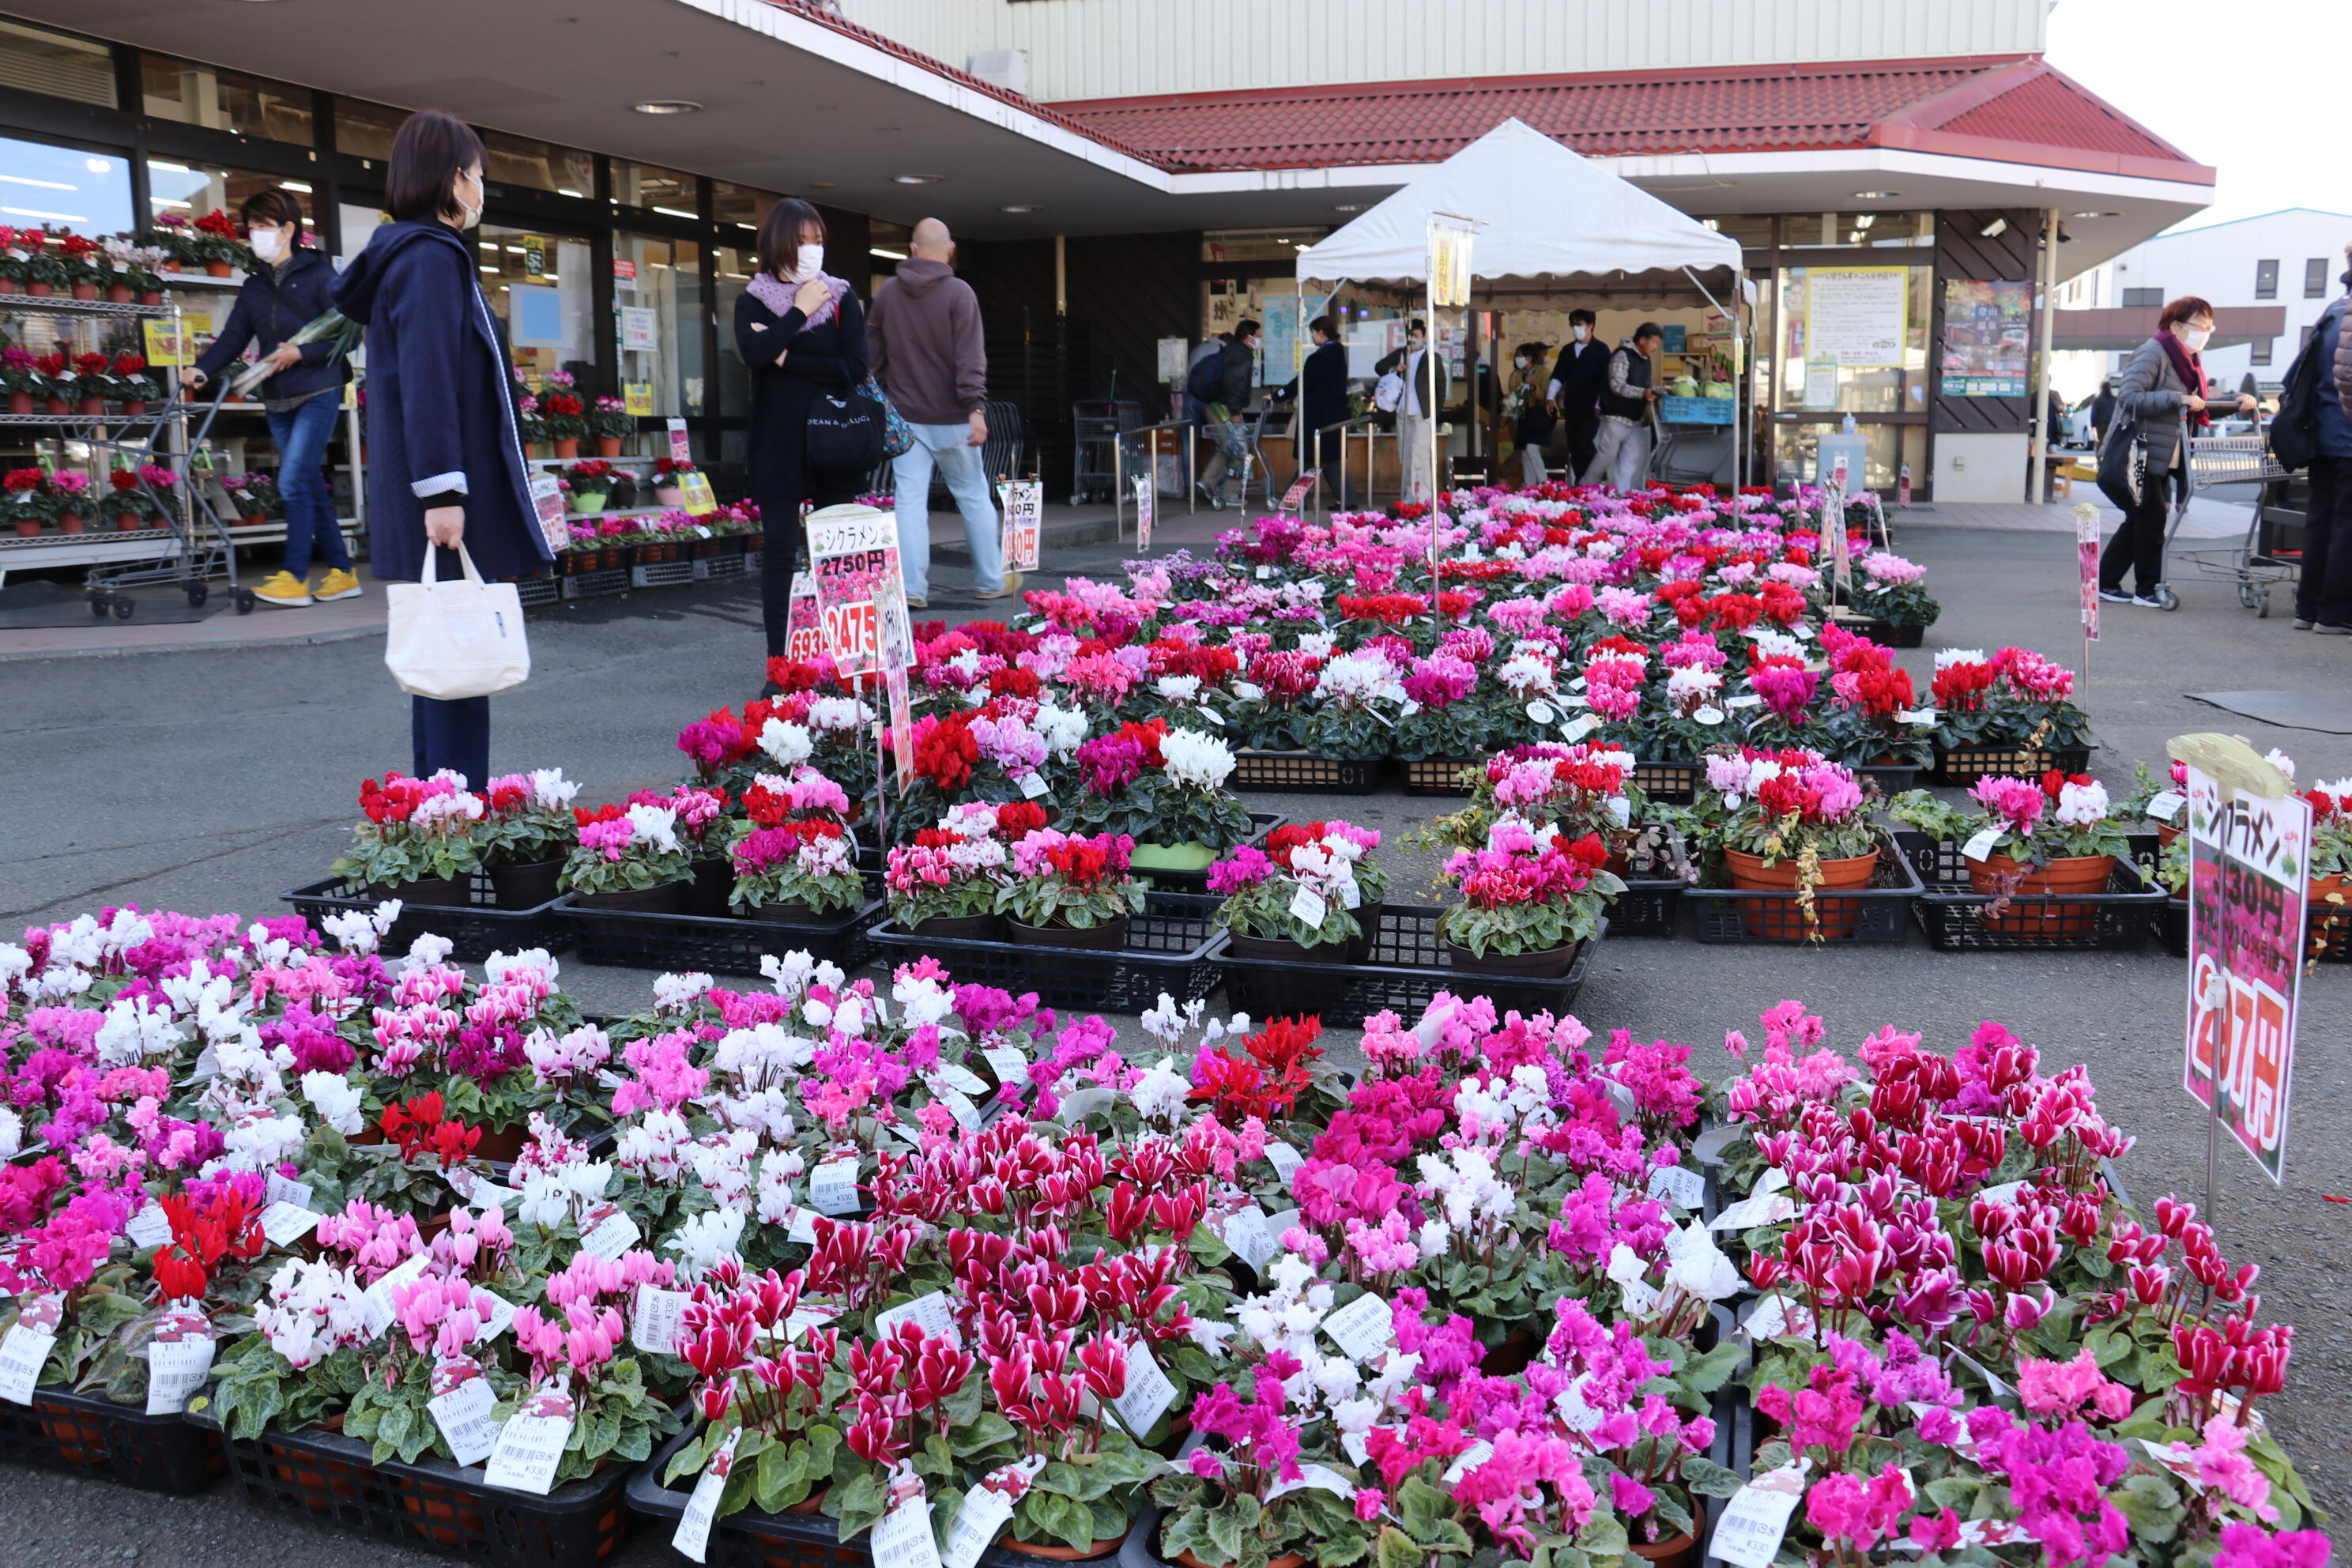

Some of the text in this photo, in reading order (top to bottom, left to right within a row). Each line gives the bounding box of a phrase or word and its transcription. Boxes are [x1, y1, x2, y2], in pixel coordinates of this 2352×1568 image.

[841, 415, 870, 428] DLUC
[826, 525, 878, 551] シクラメン
[820, 549, 885, 576] 2750円
[827, 607, 886, 659] 2475
